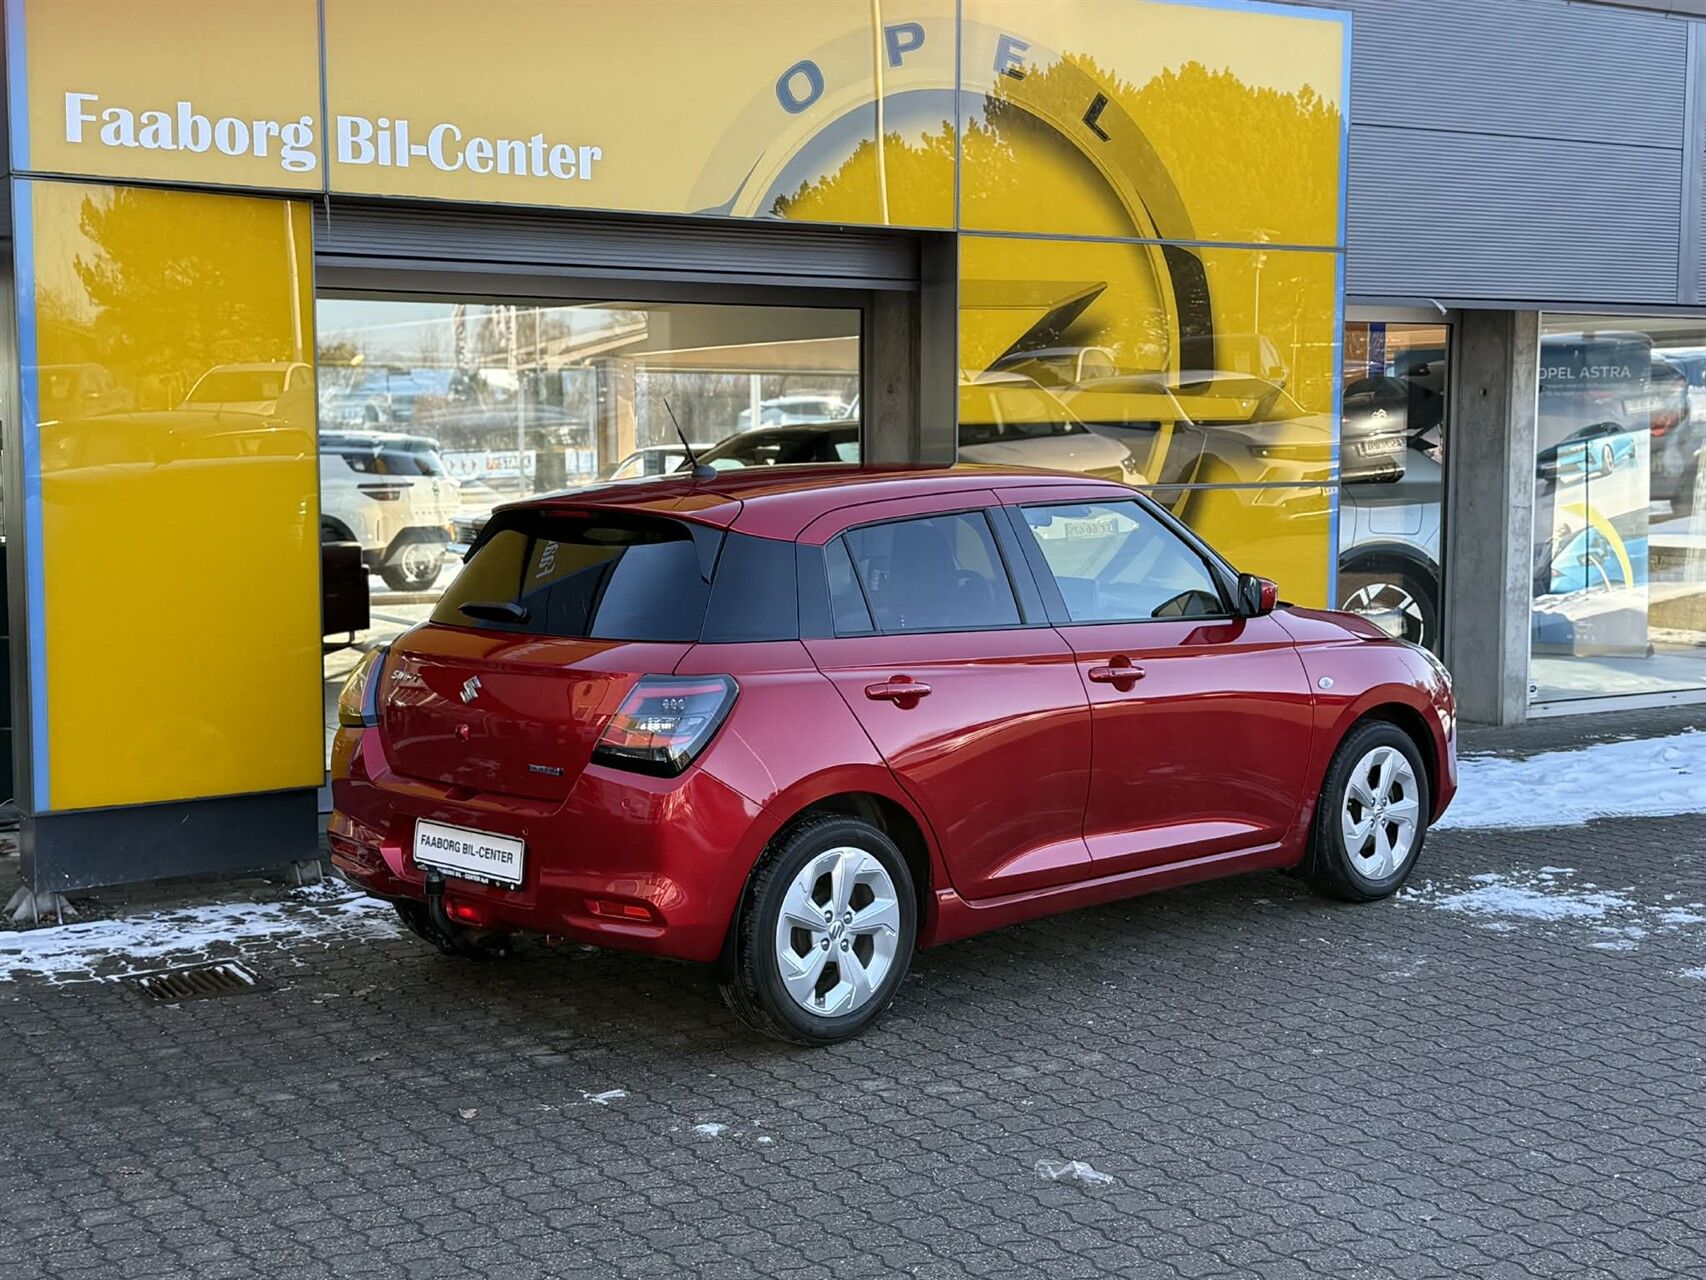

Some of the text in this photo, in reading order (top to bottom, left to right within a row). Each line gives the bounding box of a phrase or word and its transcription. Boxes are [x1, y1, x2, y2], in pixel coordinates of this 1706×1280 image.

[774, 21, 1111, 142] OPEL
[64, 91, 603, 181] Faaborg Bil-Center
[1579, 365, 1631, 379] ASTRA
[420, 834, 514, 865] FAABORG BIL-CENTER
